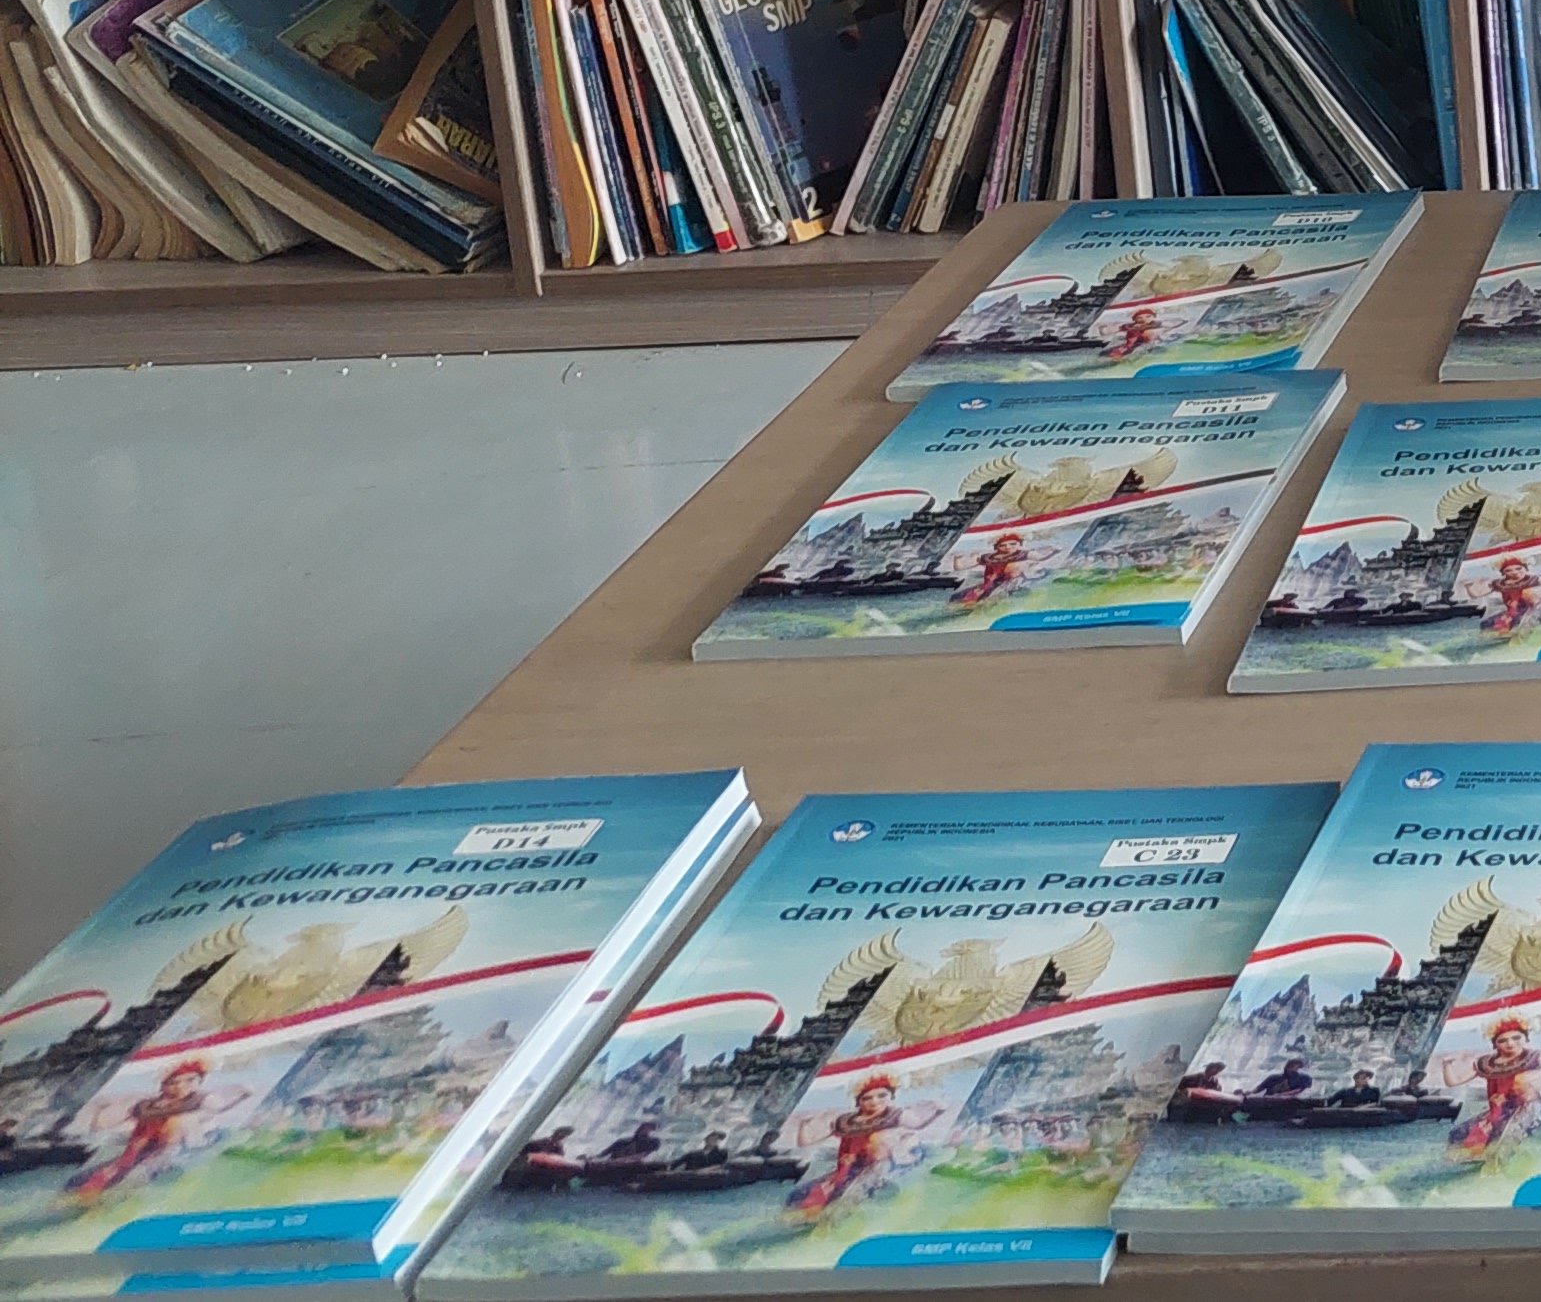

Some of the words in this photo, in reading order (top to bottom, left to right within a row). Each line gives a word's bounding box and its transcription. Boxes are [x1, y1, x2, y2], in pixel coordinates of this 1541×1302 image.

[800, 186, 823, 220] 2
[944, 420, 1108, 439] Pendidikan
[1112, 413, 1259, 433] Pancasila
[924, 438, 998, 453] dan
[1000, 429, 1255, 449] Kewarganegaraan
[1380, 463, 1441, 478] dan
[492, 834, 551, 850] D14
[1372, 846, 1448, 867] dan
[172, 858, 392, 898] Pendidikan
[396, 847, 600, 876] Pancasila
[807, 875, 1026, 896] Pendidikan
[1037, 867, 1225, 891] Pancasila
[134, 900, 209, 927] dan
[216, 873, 589, 910] Kewarganegaraan
[780, 900, 854, 922] dan
[865, 894, 1220, 920] Kewarganegaraan
